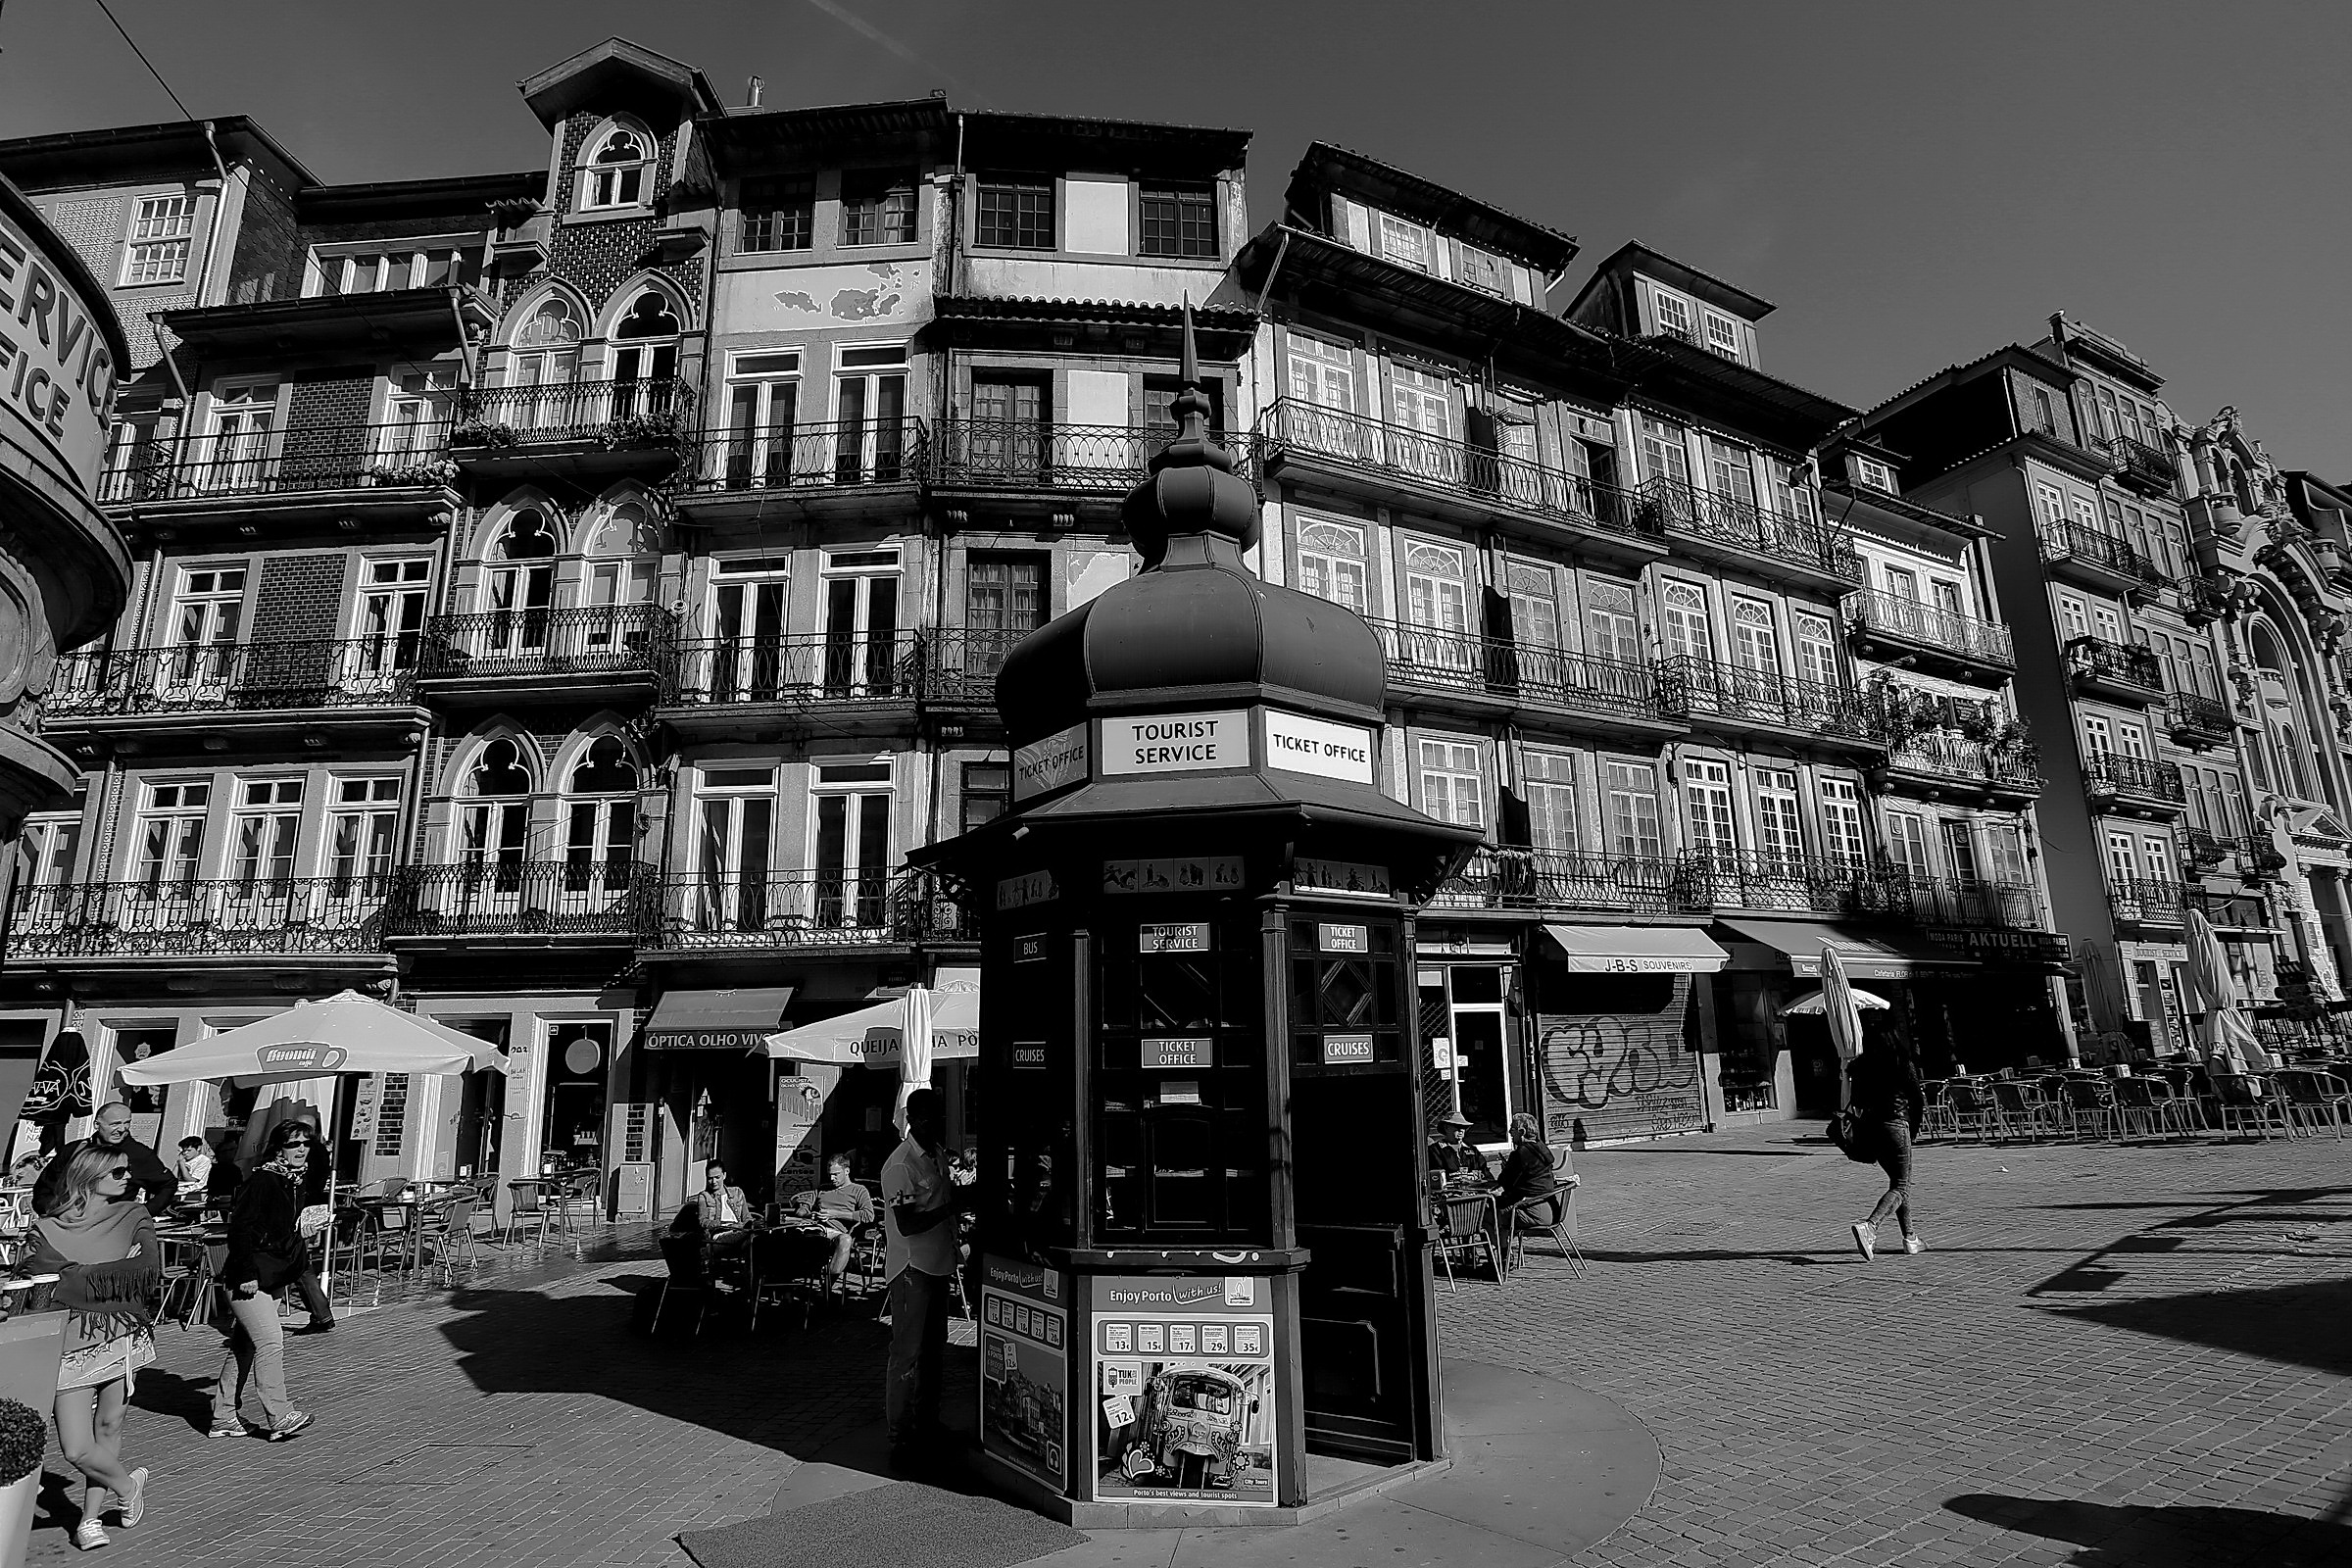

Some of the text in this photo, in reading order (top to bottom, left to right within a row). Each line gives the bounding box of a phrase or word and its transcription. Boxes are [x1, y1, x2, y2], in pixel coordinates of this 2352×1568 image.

[1131, 719, 1219, 741] TOURIST
[1134, 743, 1217, 764] SERVICE
[1273, 733, 1366, 763] TICKET OFFICE
[1018, 745, 1084, 780] TICKET OFFICE
[1152, 925, 1199, 937] TOURIST
[1330, 926, 1356, 938] TICKET
[1152, 938, 1199, 950] SERVICE
[1330, 938, 1357, 951] OFFICE
[1969, 932, 2036, 948] AKTUELL
[1023, 941, 1039, 955] BUS
[1604, 958, 1693, 972] J-B-S SOUVENIRS
[648, 1033, 695, 1048] ÓPTICA
[699, 1034, 737, 1047] OLHO
[1158, 1041, 1197, 1052] TICKET
[1015, 1049, 1045, 1061] CRUISES
[1326, 1040, 1370, 1057] CRUISES
[1158, 1054, 1197, 1064] OFFICE
[990, 1267, 1004, 1282] Enjoy
[1004, 1271, 1019, 1284] Porto
[1109, 1282, 1223, 1304] Enjoy Porto with us!
[1118, 1370, 1133, 1379] TUK
[1221, 1492, 1238, 1500] spots
